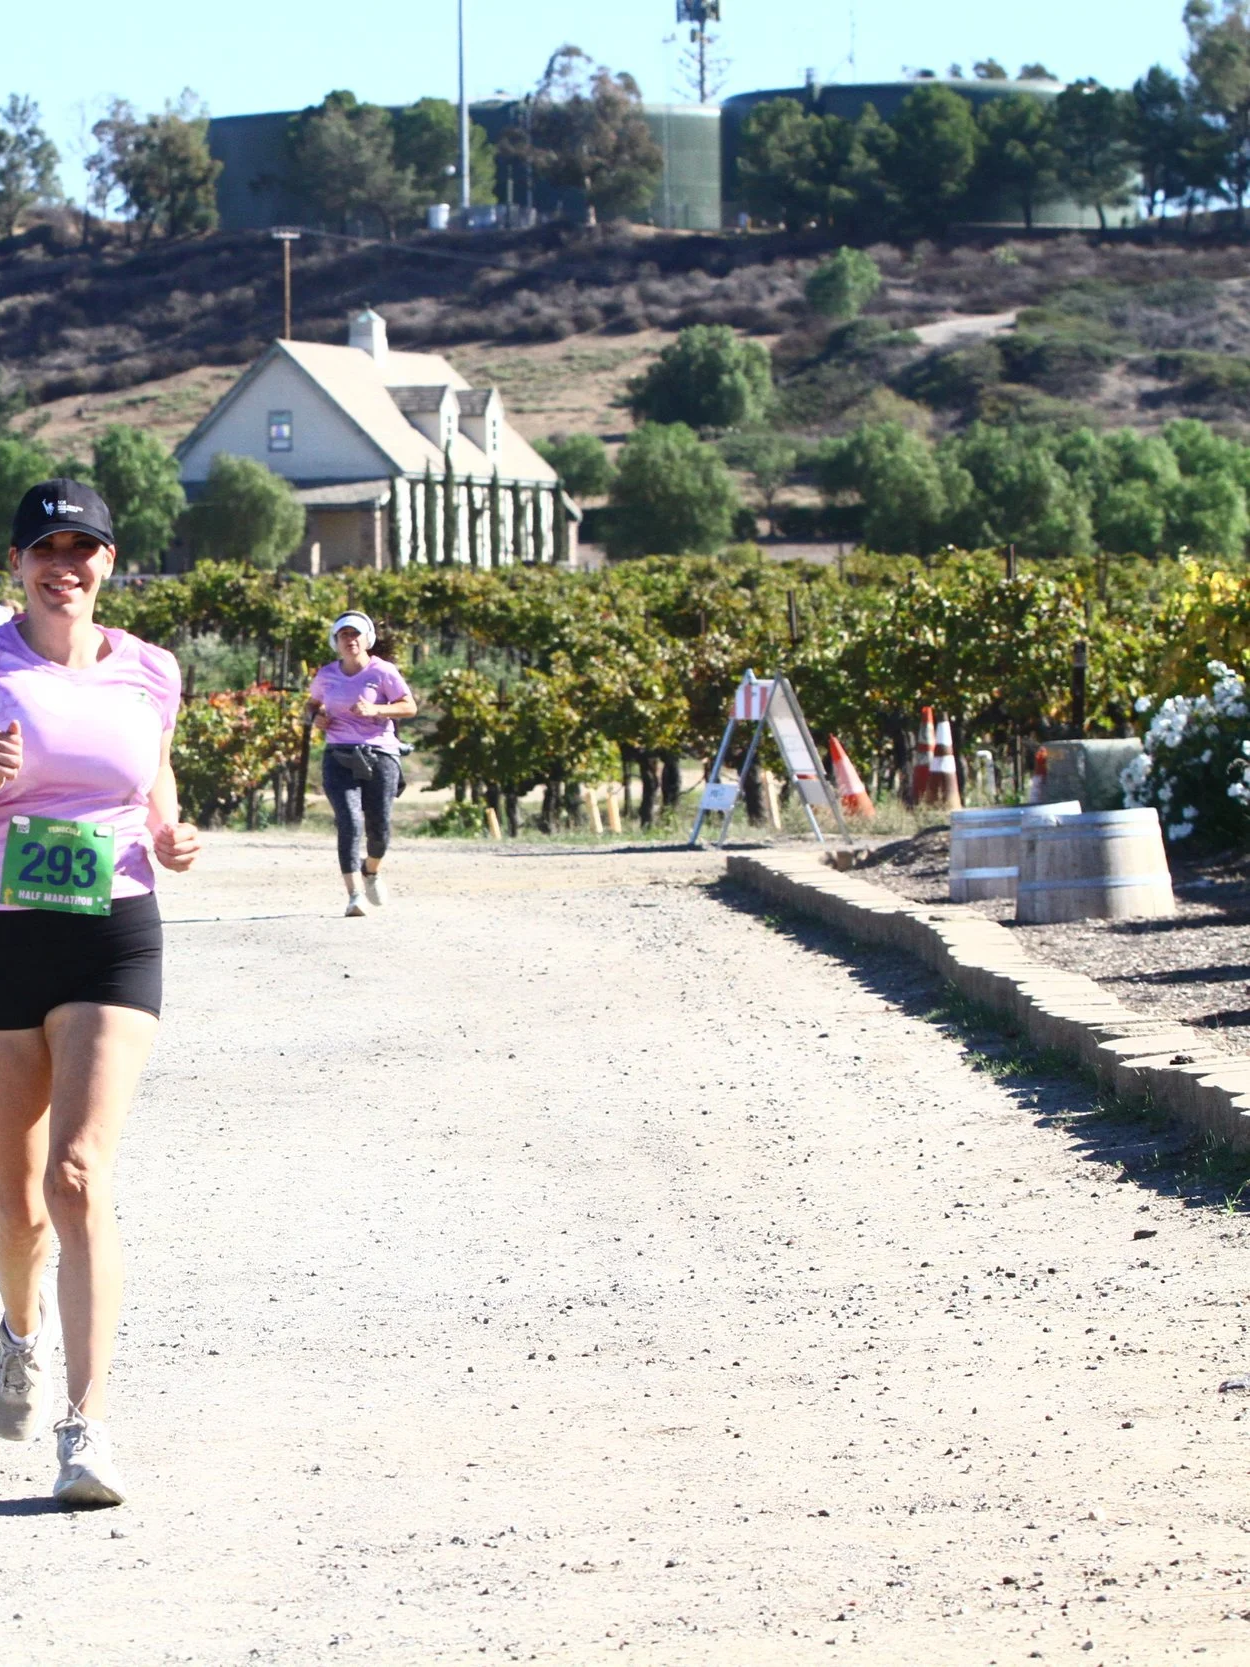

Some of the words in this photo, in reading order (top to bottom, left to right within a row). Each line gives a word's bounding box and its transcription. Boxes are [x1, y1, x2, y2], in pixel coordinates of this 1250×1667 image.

[19, 842, 97, 888] 293
[19, 890, 42, 900] HALF
[44, 893, 93, 905] MARATHON
